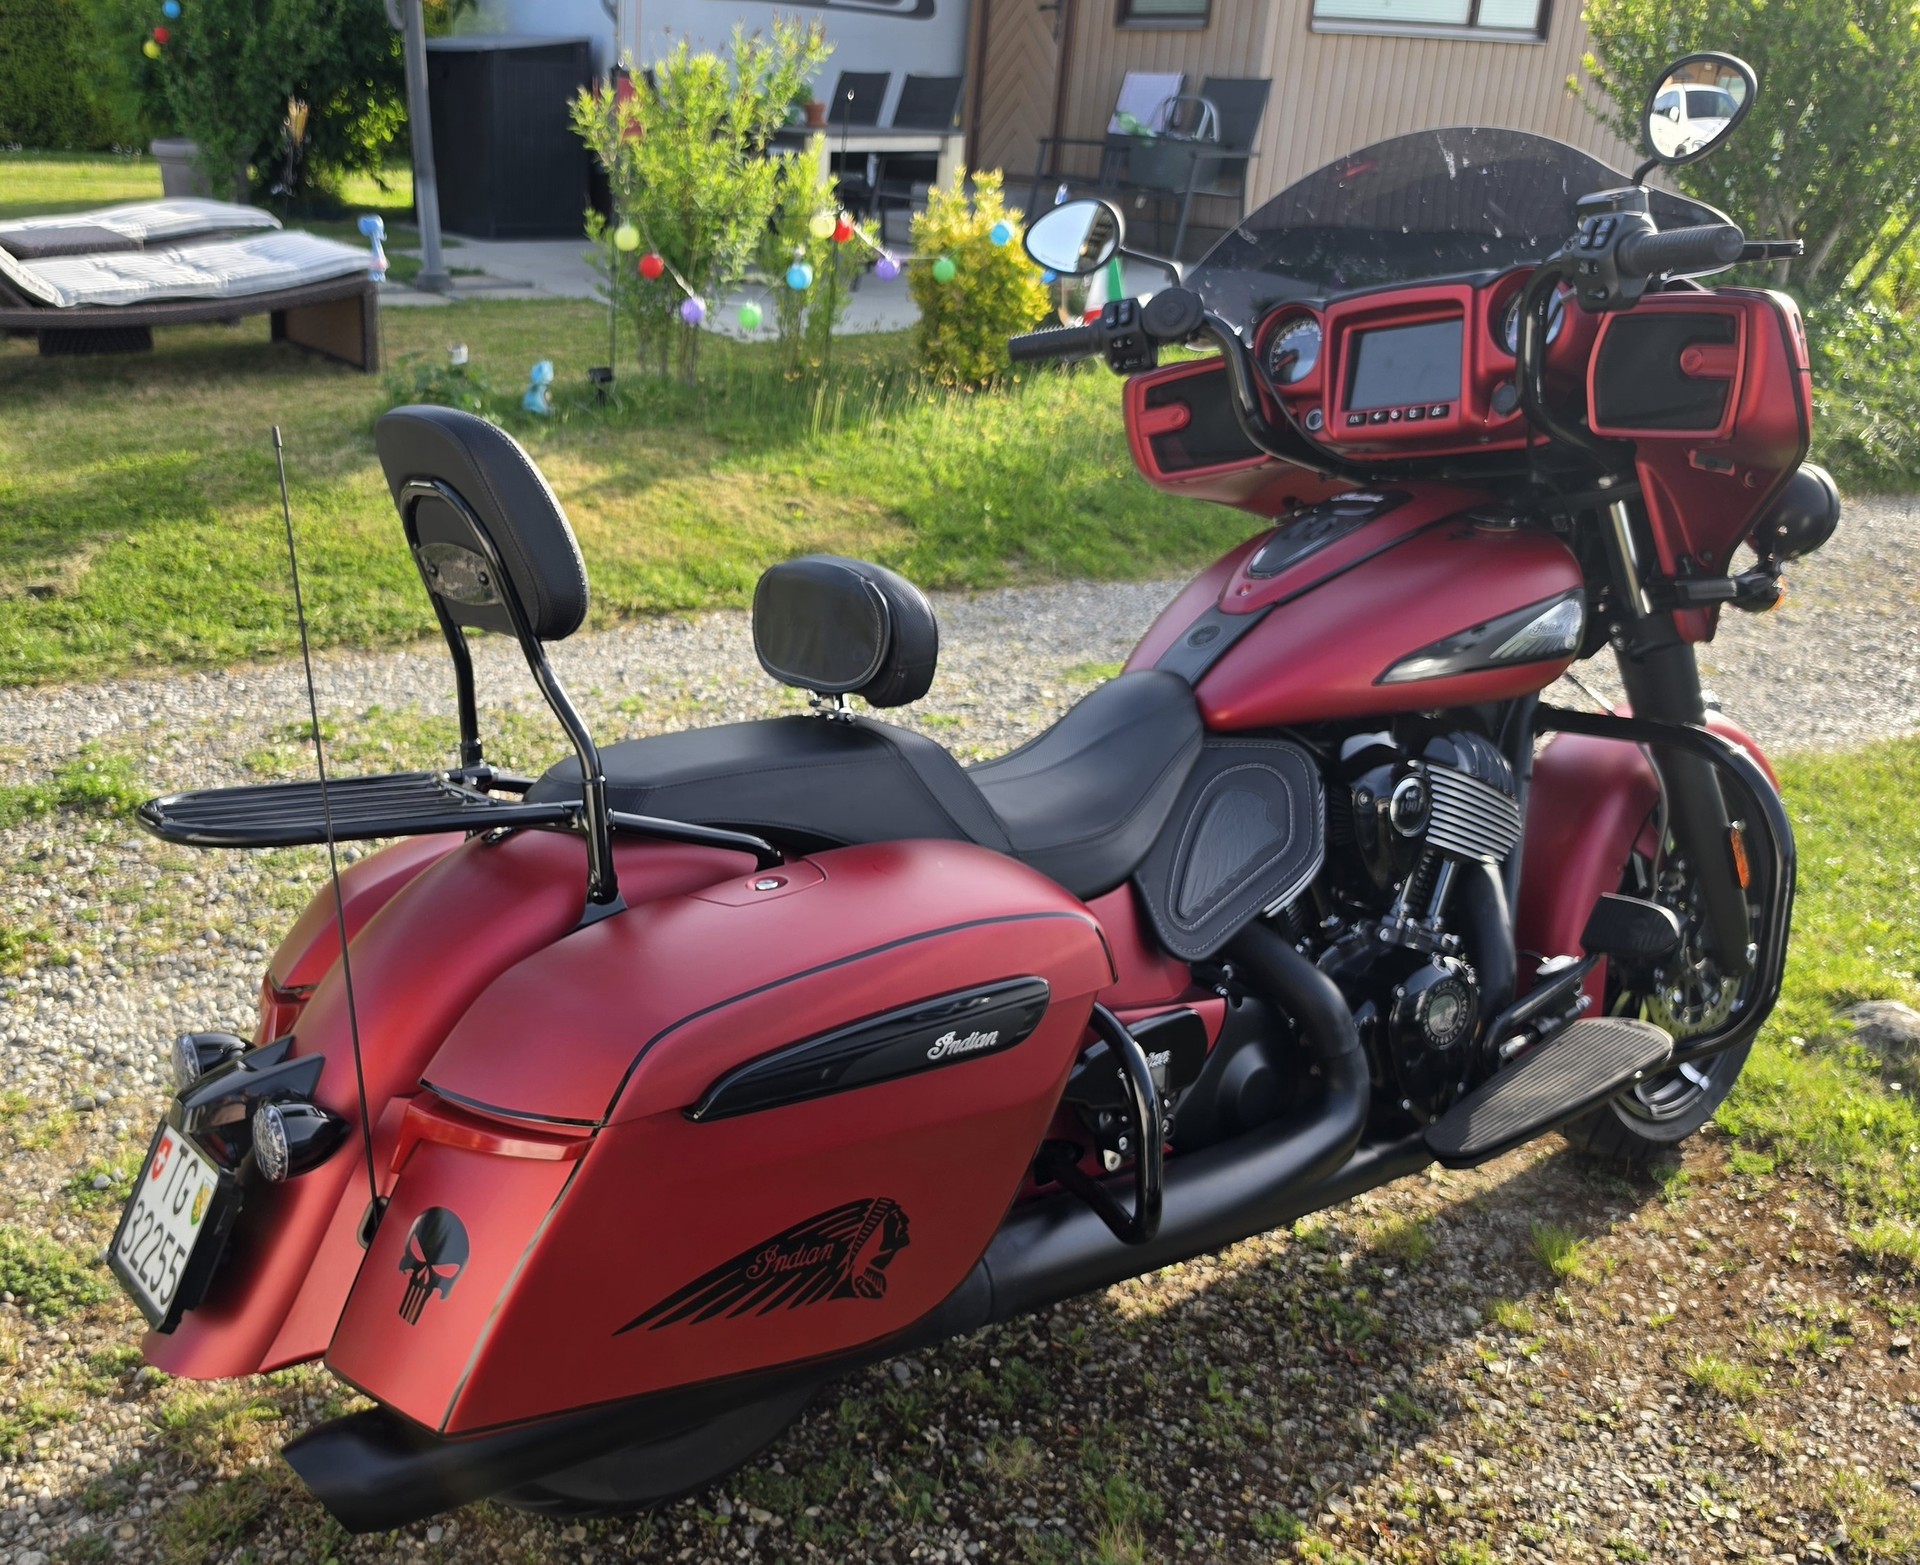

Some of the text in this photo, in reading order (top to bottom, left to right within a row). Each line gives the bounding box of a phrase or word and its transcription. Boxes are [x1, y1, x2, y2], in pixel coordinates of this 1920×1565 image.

[926, 1030, 999, 1060] Indian
[162, 1143, 199, 1217] TG
[121, 1199, 187, 1306] 32255
[746, 1243, 834, 1280] Indian
